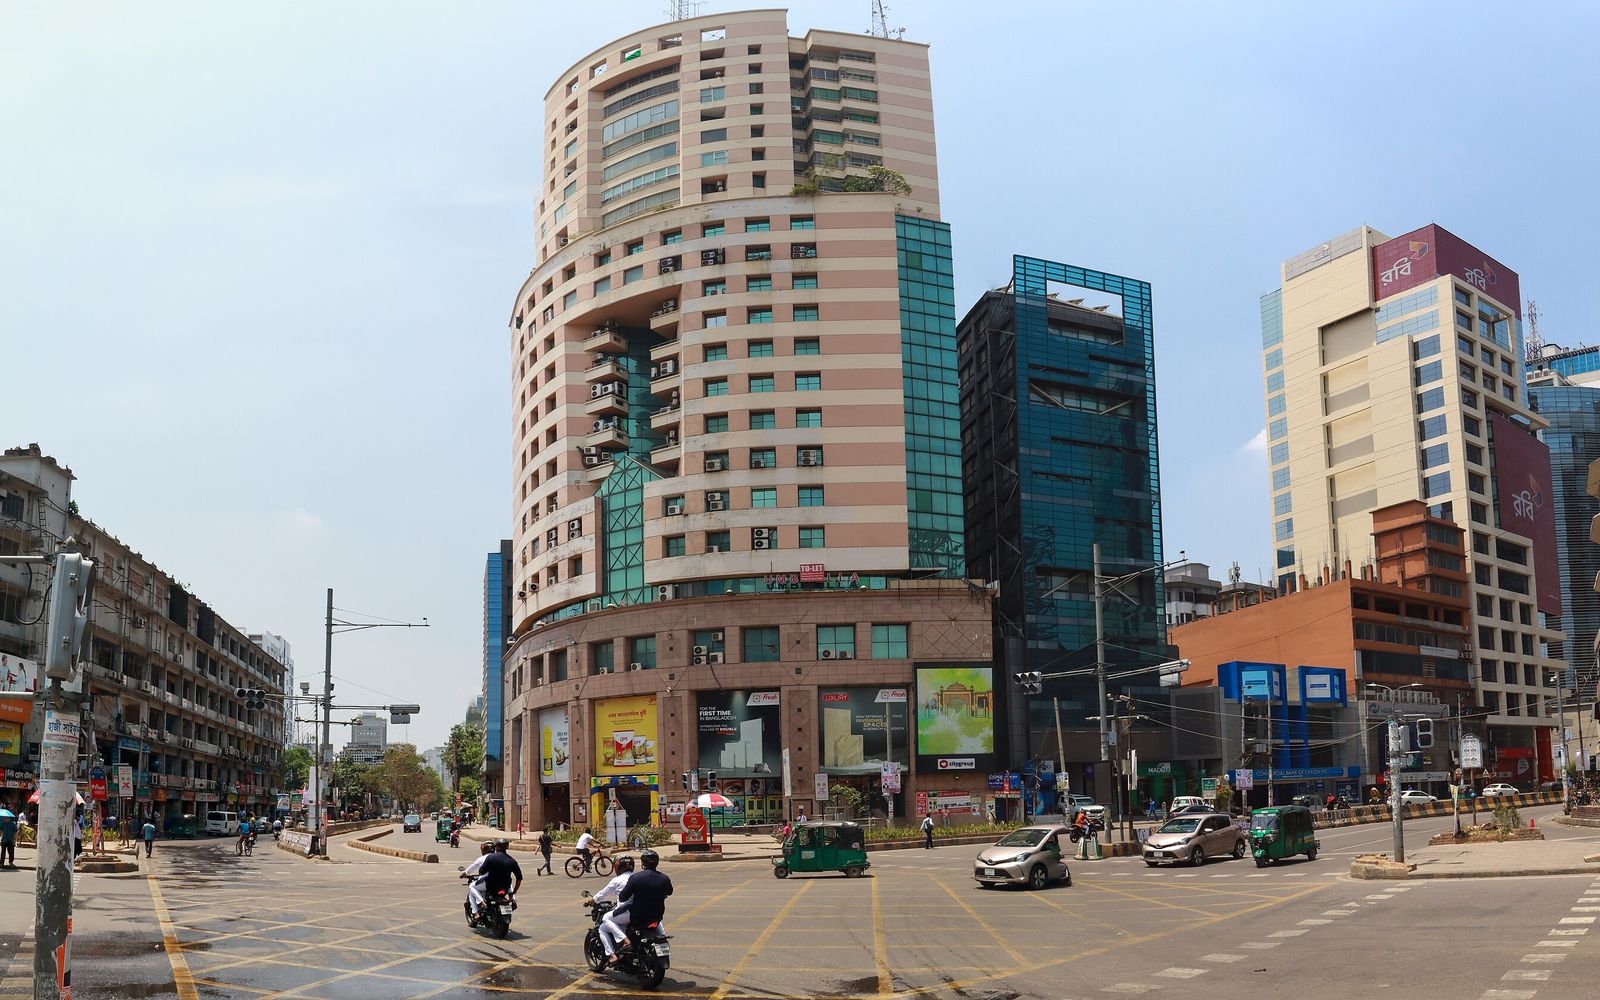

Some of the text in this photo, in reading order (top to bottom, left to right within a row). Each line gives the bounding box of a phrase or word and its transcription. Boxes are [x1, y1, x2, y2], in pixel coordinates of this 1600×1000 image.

[1380, 257, 1412, 287] রবি
[1463, 267, 1487, 292] রবি
[1512, 490, 1534, 522] রবি
